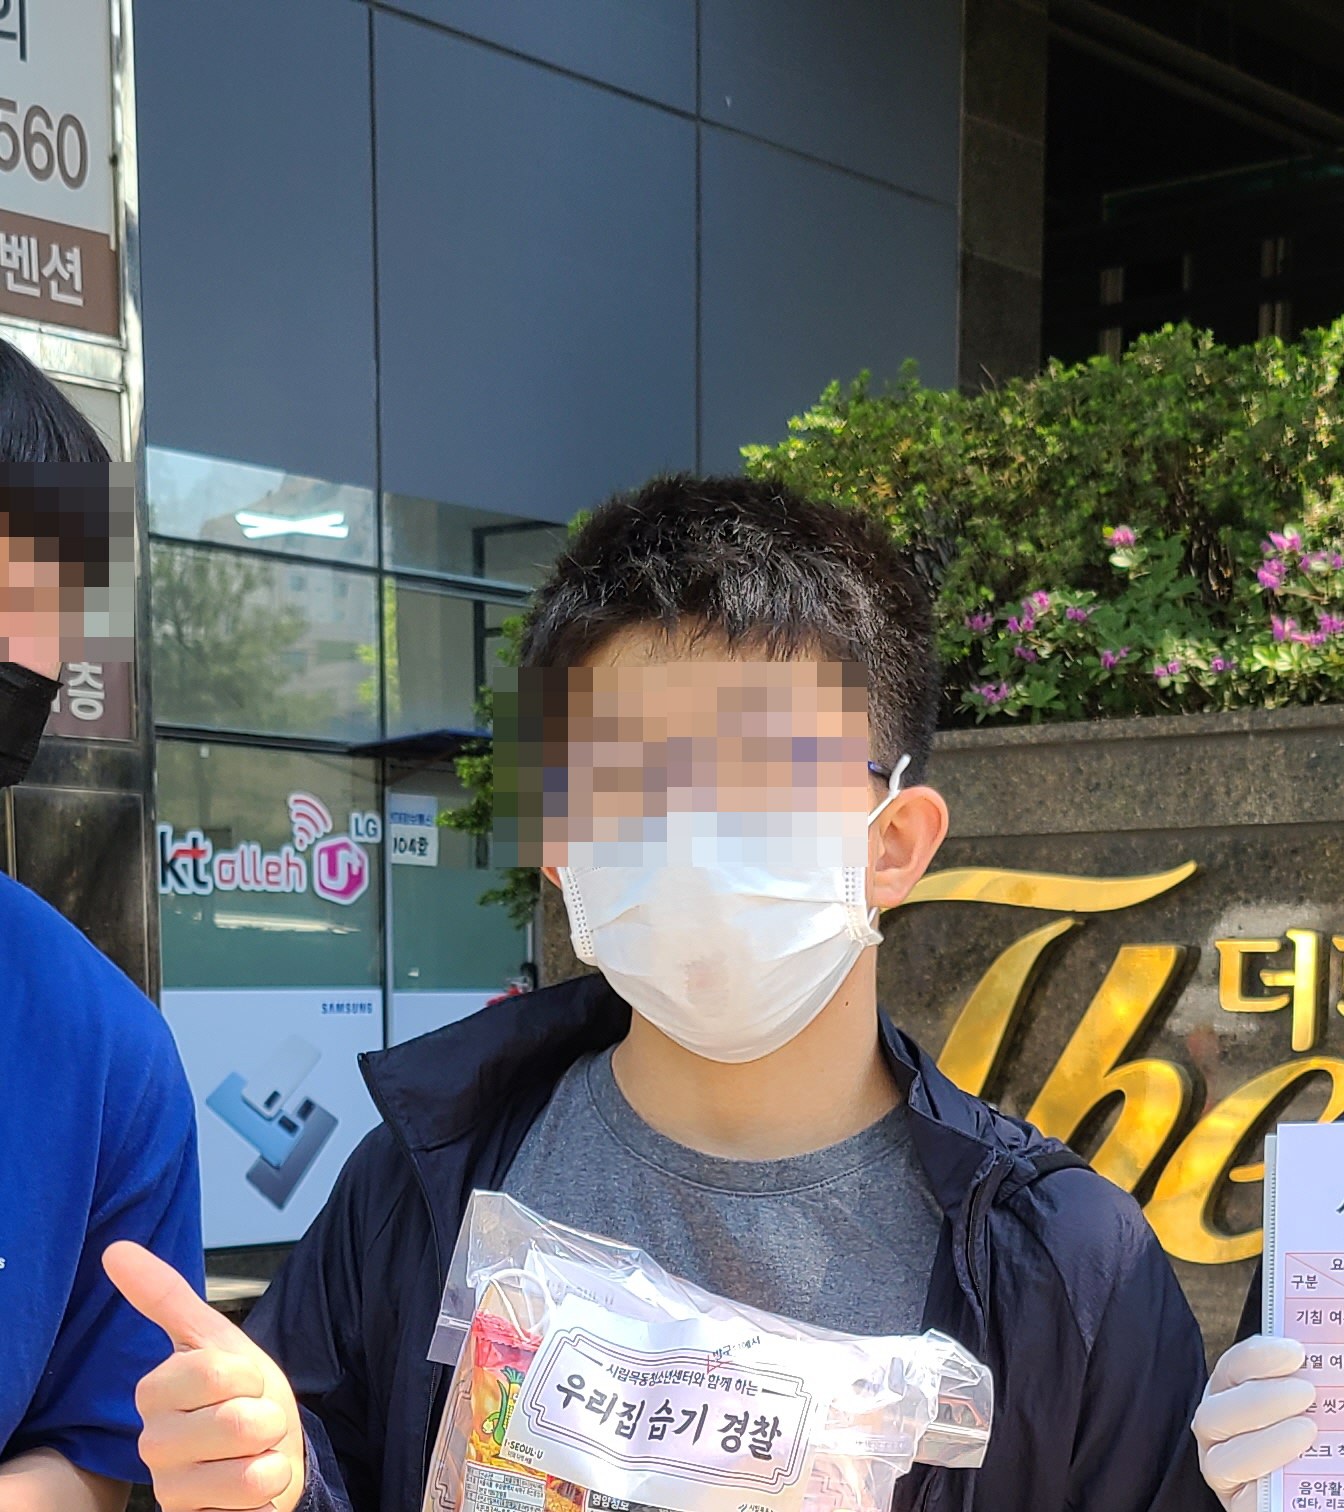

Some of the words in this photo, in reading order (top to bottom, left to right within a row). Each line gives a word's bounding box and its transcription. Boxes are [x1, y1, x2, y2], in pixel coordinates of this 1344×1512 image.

[354, 816, 378, 838] LG
[159, 830, 208, 888] kt
[218, 849, 303, 888] olleh
[321, 1002, 373, 1015] SAMSUNG
[1291, 1275, 1318, 1290] 구분
[1296, 1310, 1323, 1325] 기침
[606, 1363, 706, 1388] 시립목동청소년센터와
[708, 1373, 733, 1392] 함께
[735, 1378, 759, 1397] 하는
[556, 1373, 646, 1440] 우리집
[647, 1398, 709, 1446] 습기
[717, 1411, 782, 1461] 경찰
[1299, 1445, 1333, 1459] 스크
